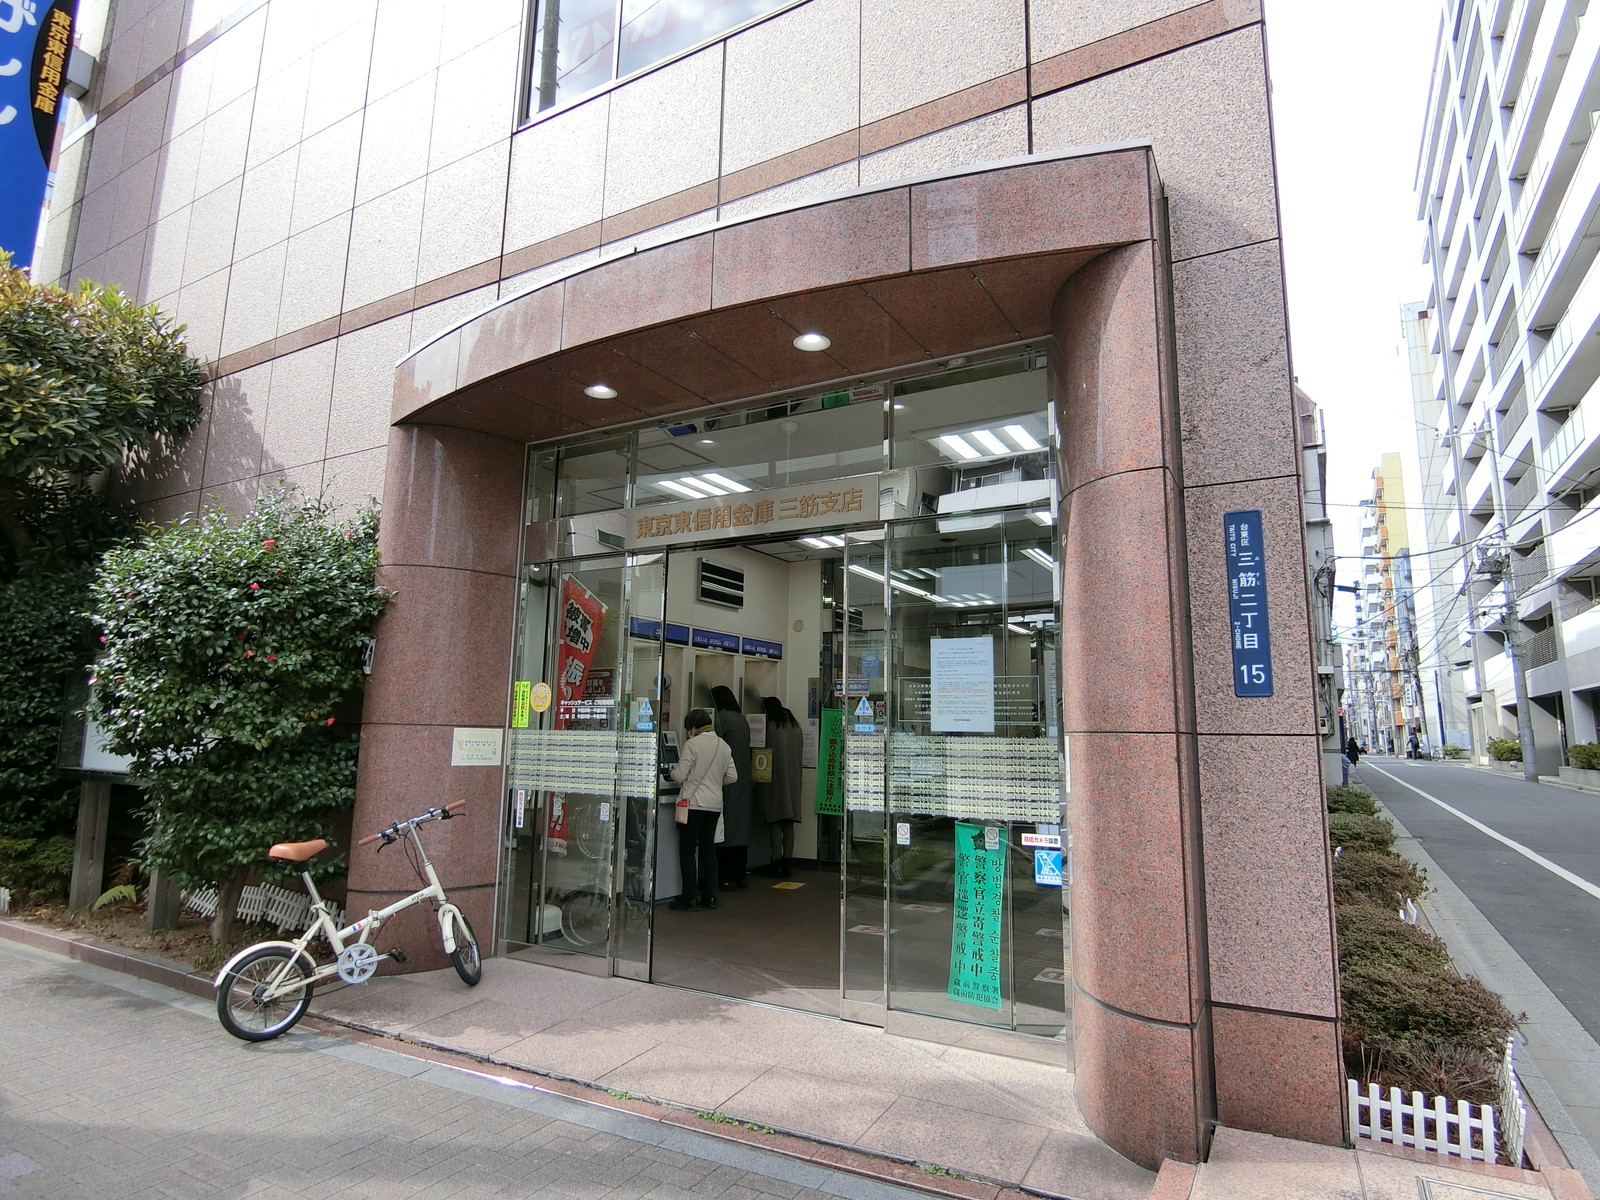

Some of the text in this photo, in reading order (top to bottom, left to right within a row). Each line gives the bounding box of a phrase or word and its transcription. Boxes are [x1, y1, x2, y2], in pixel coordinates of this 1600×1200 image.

[34, 8, 72, 115] 東京東信用金庫
[1228, 524, 1236, 543] TAITO
[1234, 621, 1242, 649] 2-CHOME
[1238, 522, 1258, 649] 台東区 三筋二丁目
[1240, 664, 1266, 685] 15
[970, 855, 987, 978] 警察官立寄警戒中
[988, 858, 1003, 982] 방범경찰 순찰중
